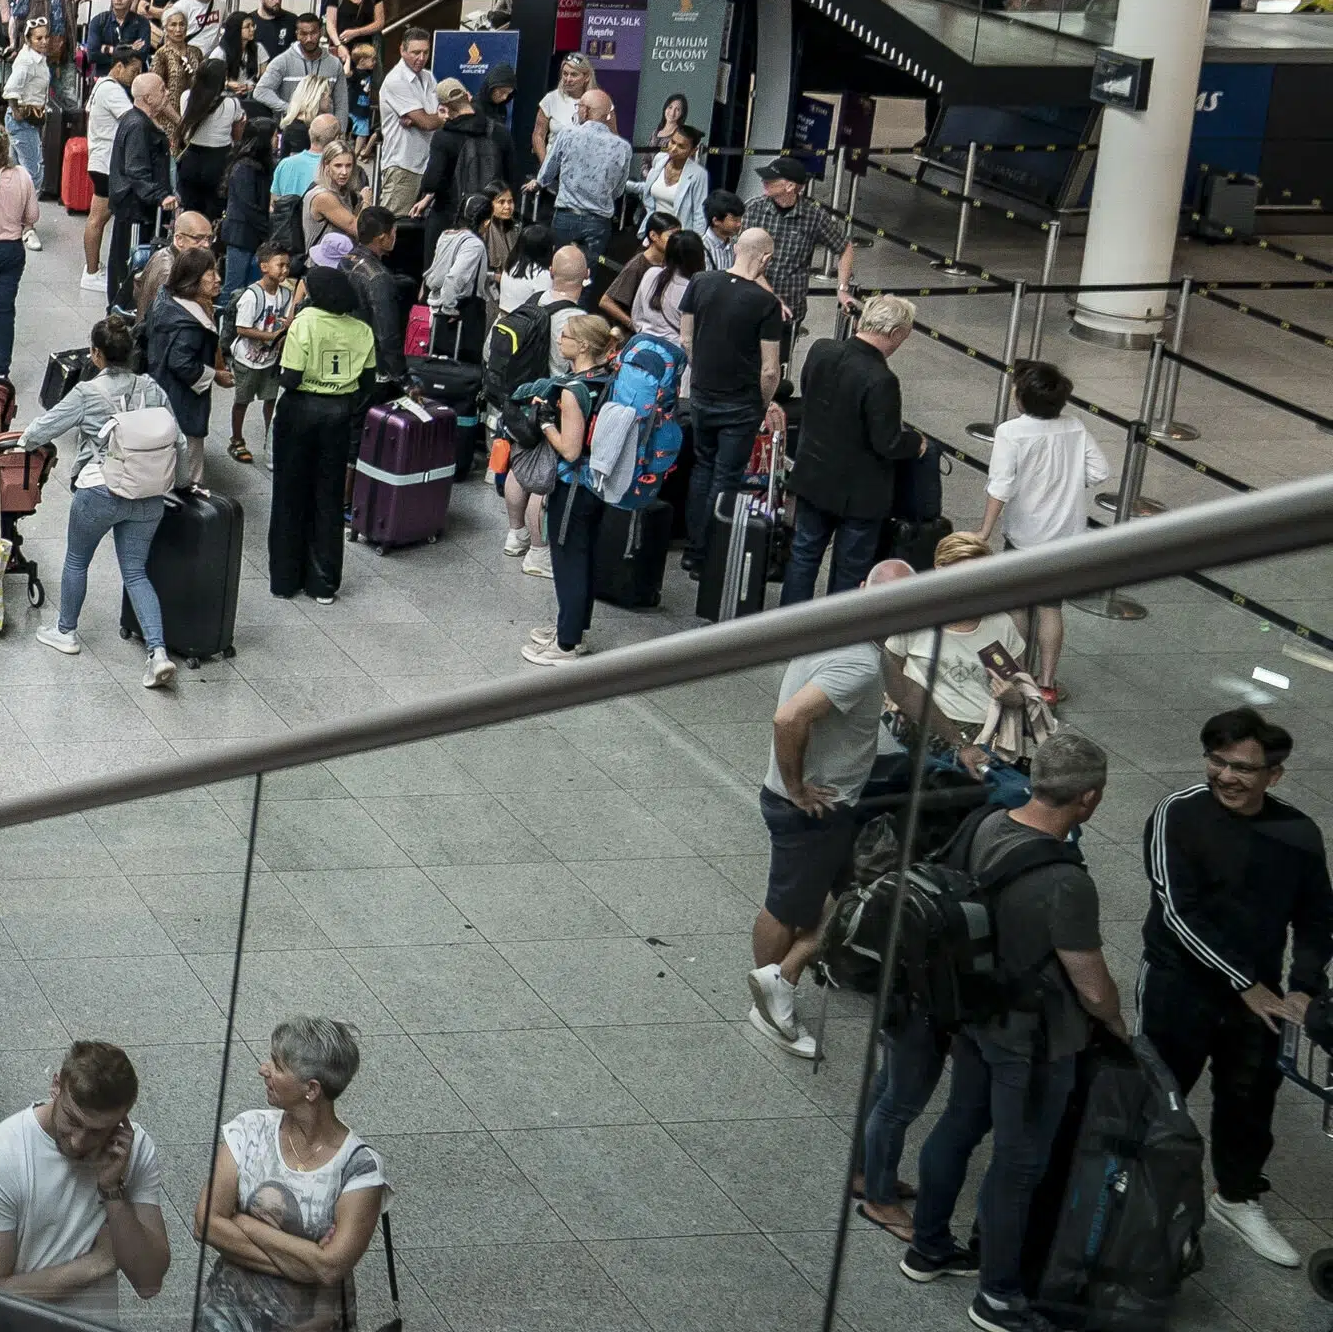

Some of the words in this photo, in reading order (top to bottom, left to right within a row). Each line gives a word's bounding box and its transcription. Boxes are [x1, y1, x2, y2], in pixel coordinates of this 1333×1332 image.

[588, 15, 619, 26] ROYAL
[621, 17, 641, 26] SILK
[655, 36, 708, 48] PREMIUM
[652, 48, 708, 60] ECONOMY
[661, 60, 695, 72] CLASS
[1194, 91, 1224, 112] AS
